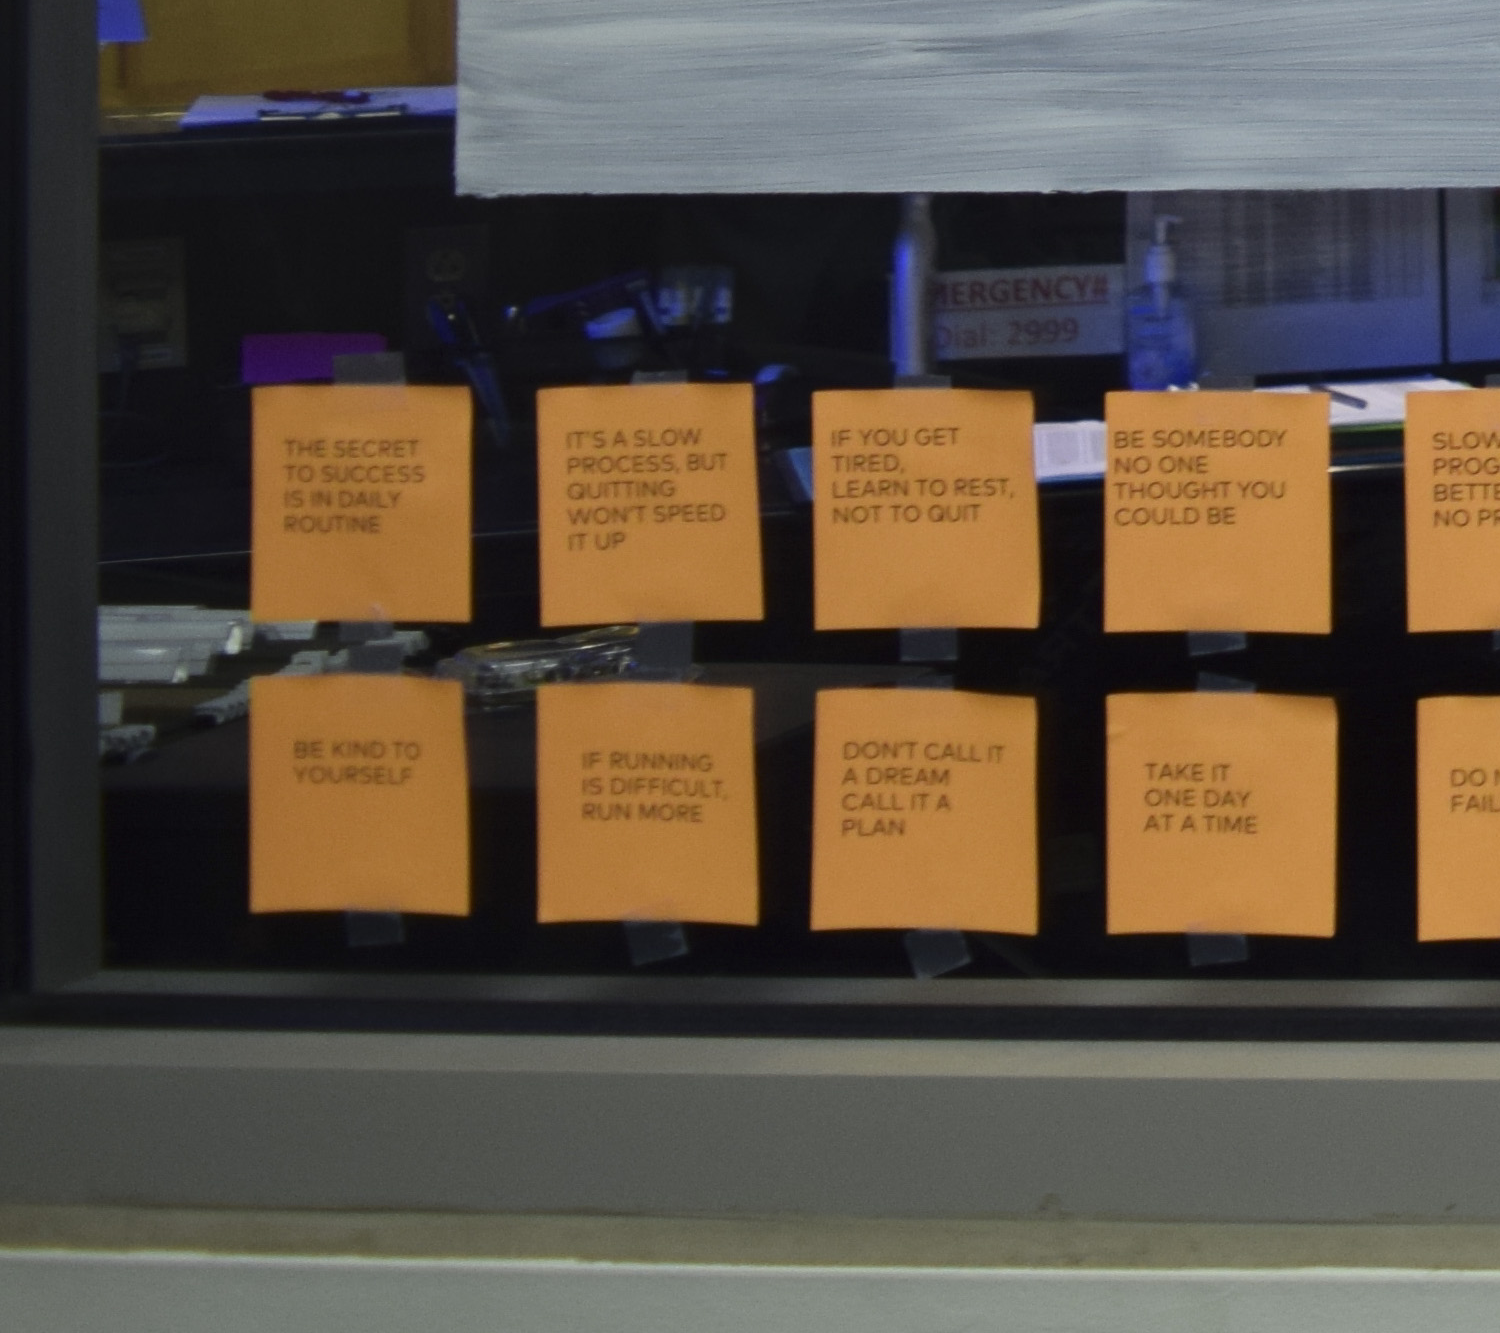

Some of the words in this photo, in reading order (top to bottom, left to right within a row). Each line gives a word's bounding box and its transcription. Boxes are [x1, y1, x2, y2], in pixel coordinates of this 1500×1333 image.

[1008, 317, 1079, 347] 2999
[1113, 429, 1145, 450] BE
[1152, 428, 1288, 449] SOMEBODY
[1113, 455, 1152, 475] NO
[1157, 454, 1209, 475] ONE
[1112, 480, 1233, 501] THOUGHT
[1236, 480, 1286, 500] YOU
[1113, 506, 1201, 527] COULD
[1206, 505, 1236, 526] BE
